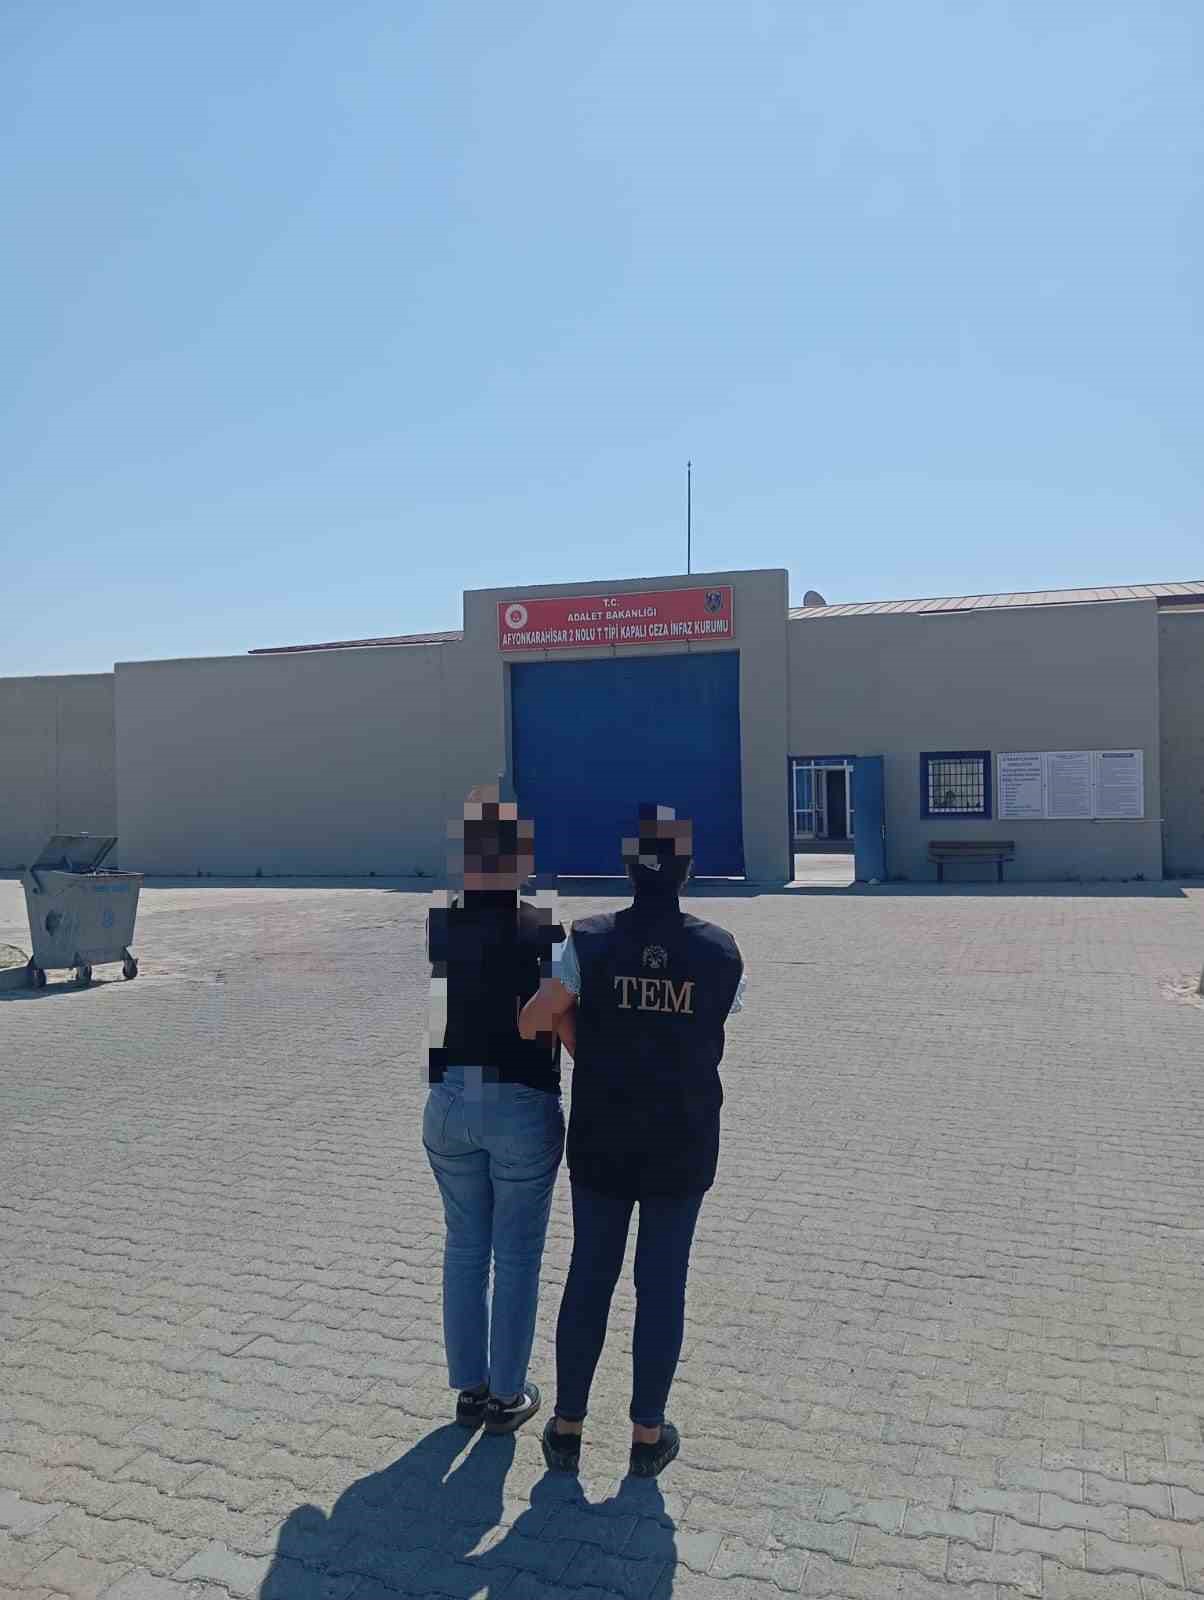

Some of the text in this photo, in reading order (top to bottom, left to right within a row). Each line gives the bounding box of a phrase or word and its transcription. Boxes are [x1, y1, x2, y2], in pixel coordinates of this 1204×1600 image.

[567, 611, 602, 622] ADALET
[502, 627, 567, 645] AFYONKARAHİSAR
[568, 629, 574, 640] 2
[575, 628, 595, 641] NOLU
[603, 624, 618, 640] TİPİ
[620, 624, 647, 638] KAPALI
[648, 623, 669, 636] CEZA
[670, 620, 692, 635] İNFAZ
[694, 619, 729, 634] KURUMU
[613, 975, 695, 1014] TEM
